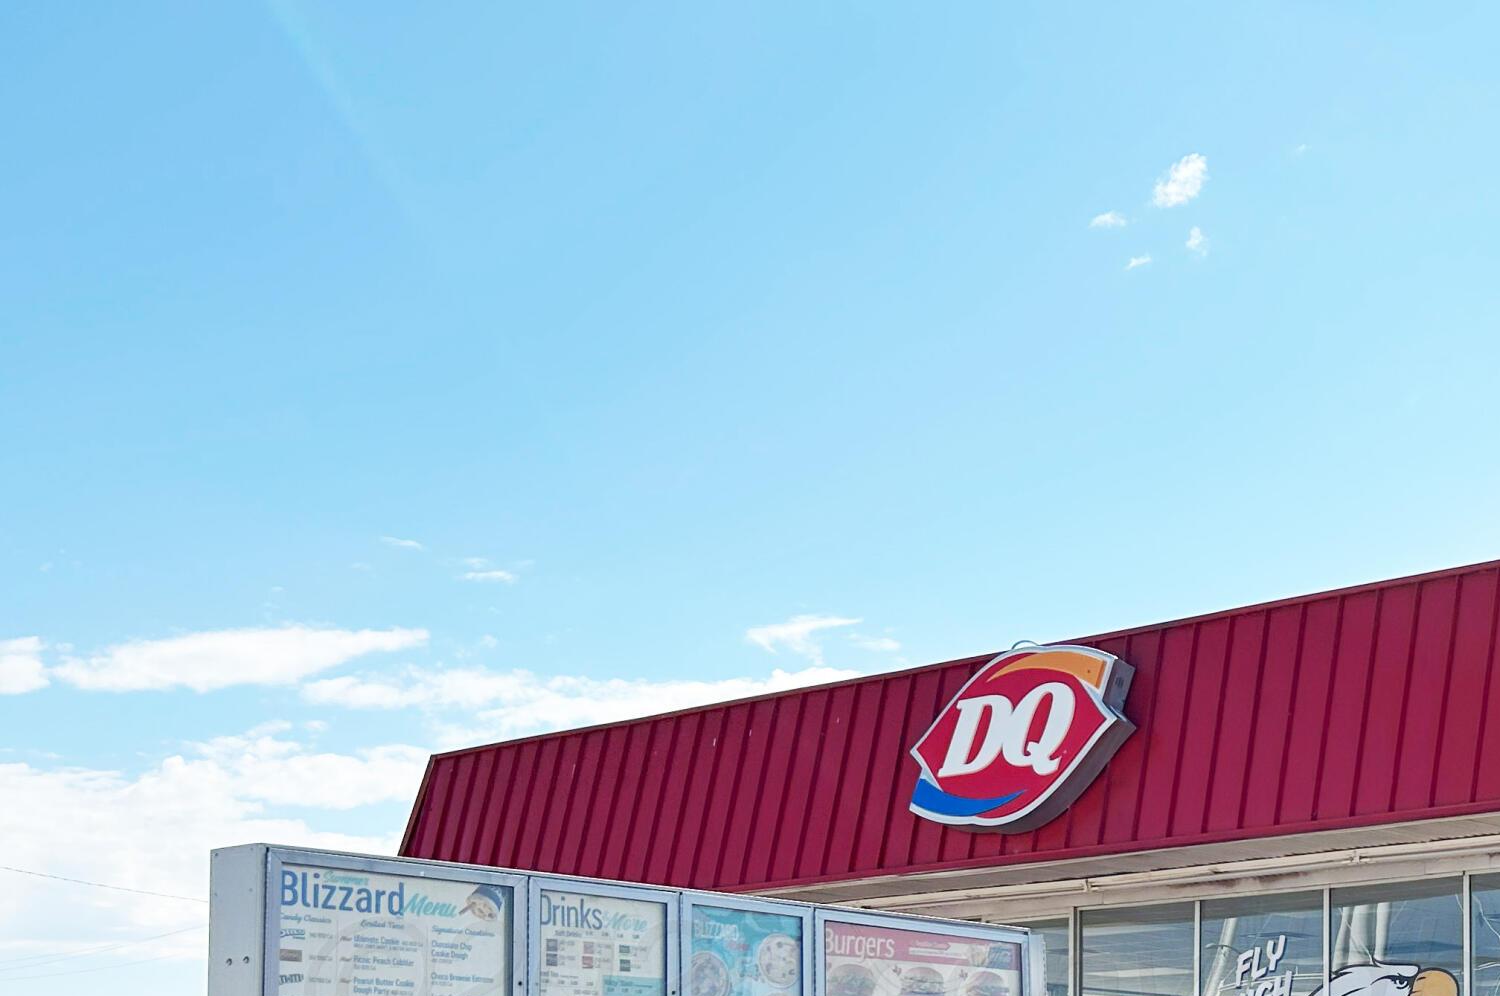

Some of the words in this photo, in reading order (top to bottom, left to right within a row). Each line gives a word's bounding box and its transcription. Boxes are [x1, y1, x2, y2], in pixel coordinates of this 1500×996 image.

[938, 682, 1076, 777] DQ
[281, 870, 405, 916] Blizzard
[403, 893, 458, 918] Menu
[541, 894, 603, 930] Drinks
[826, 928, 896, 963] Burgers
[1235, 935, 1286, 989] FLY
